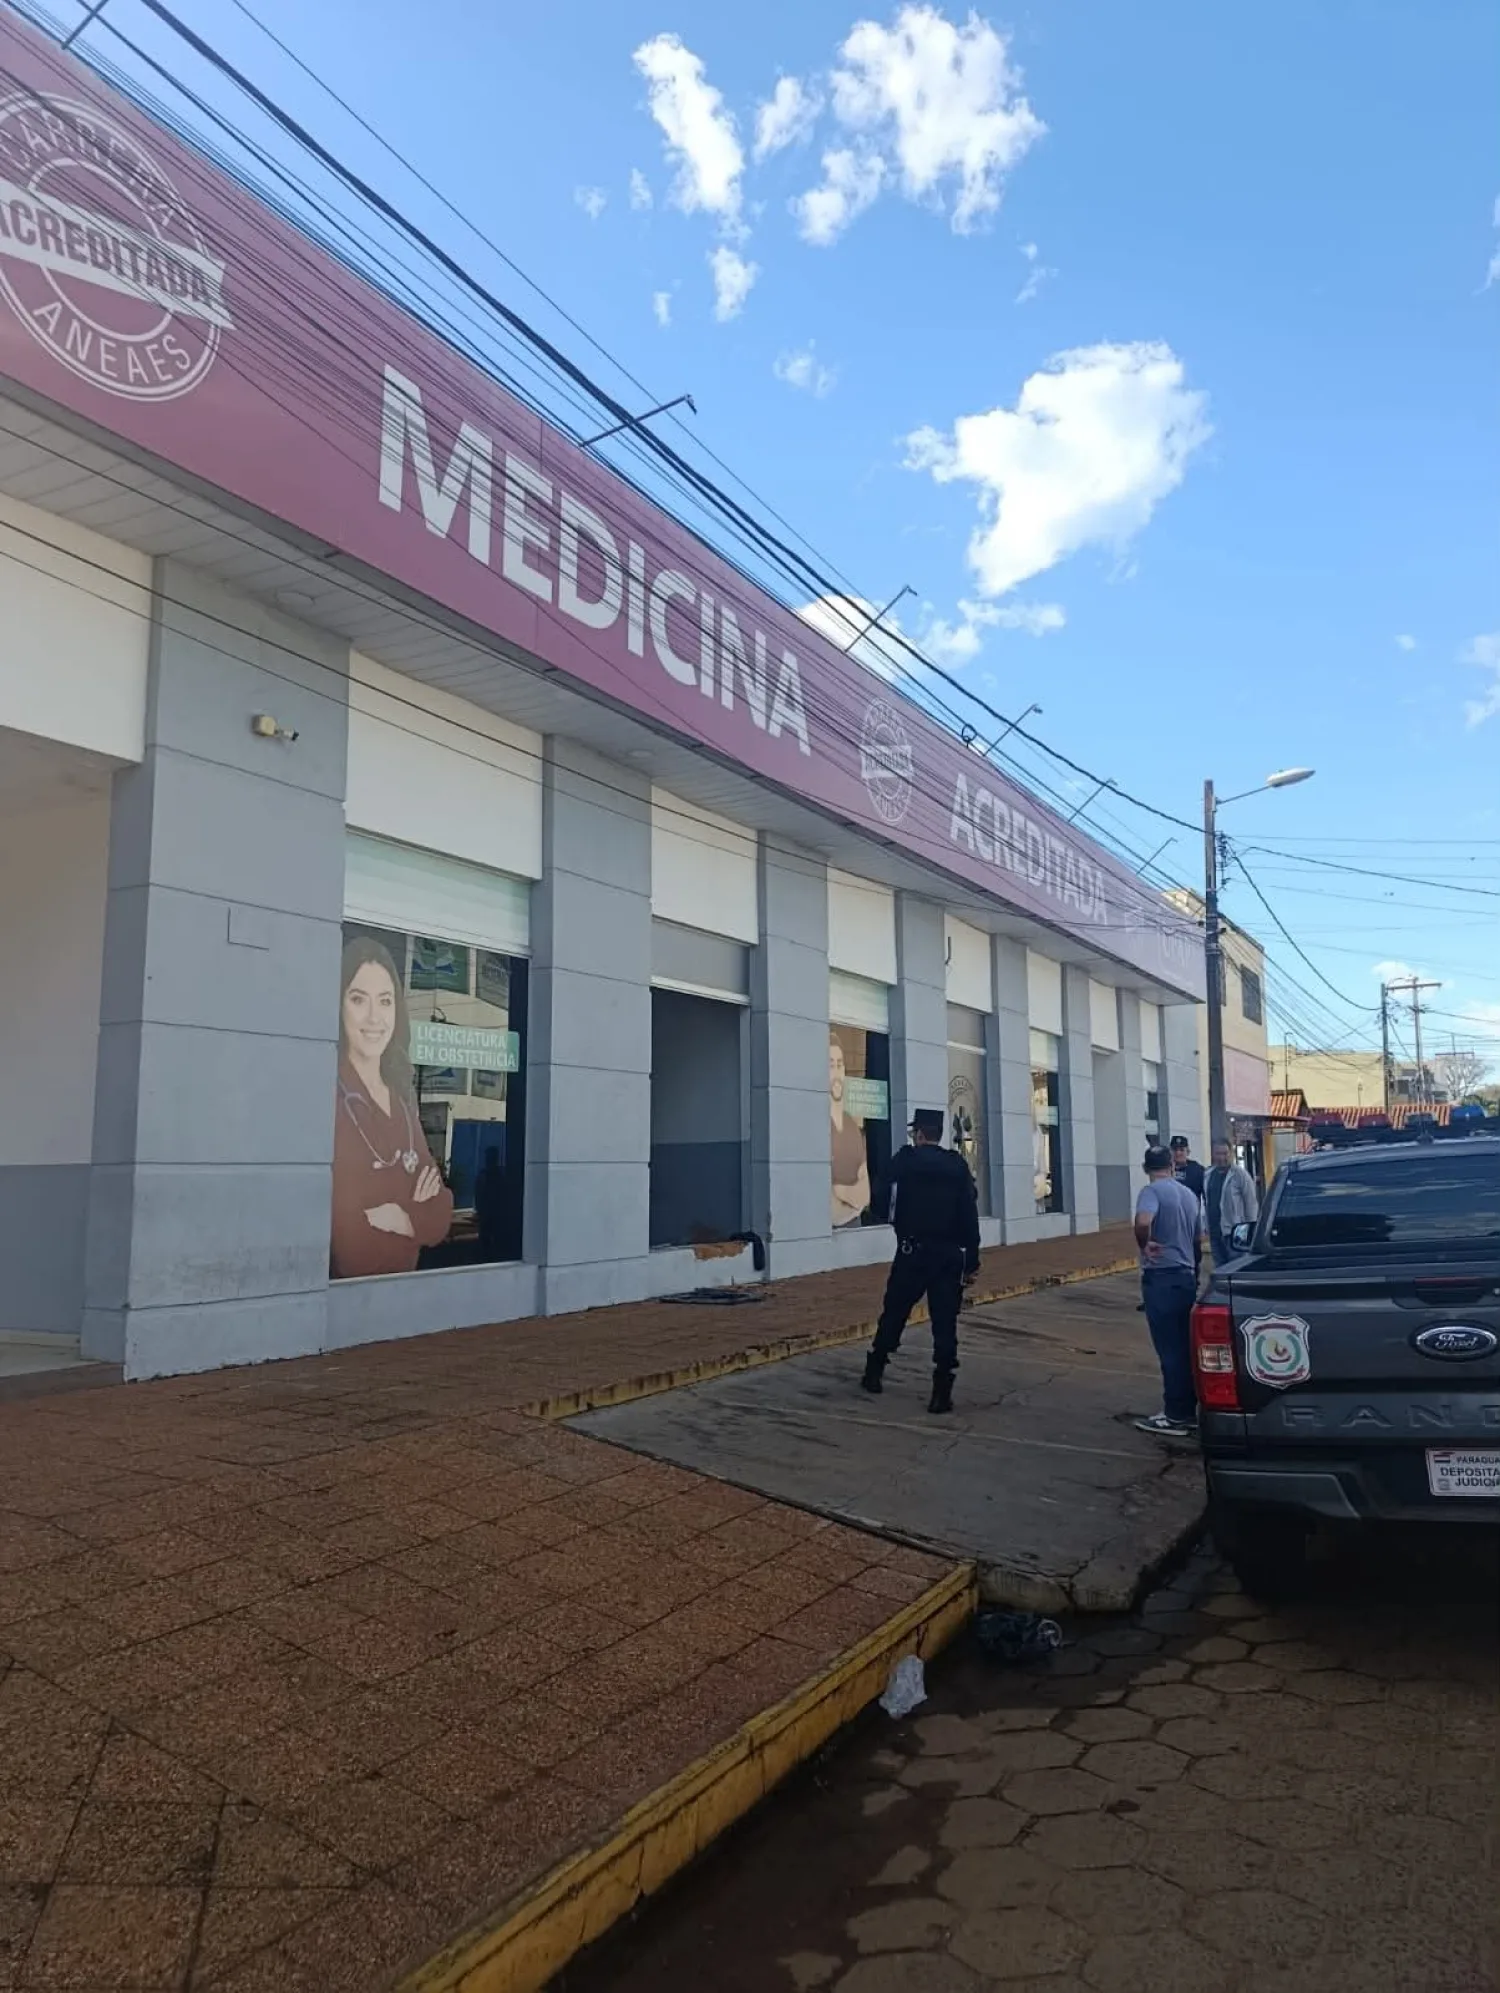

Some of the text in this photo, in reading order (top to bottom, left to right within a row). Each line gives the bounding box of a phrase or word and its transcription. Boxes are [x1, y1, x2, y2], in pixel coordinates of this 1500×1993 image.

[33, 300, 191, 384] ANEAES
[378, 363, 811, 757] MEDICINA
[950, 772, 1108, 925] ACREDITADA
[415, 1044, 436, 1061] EN
[417, 1025, 508, 1051] LICENCIATURA
[1434, 1332, 1479, 1350] Ford
